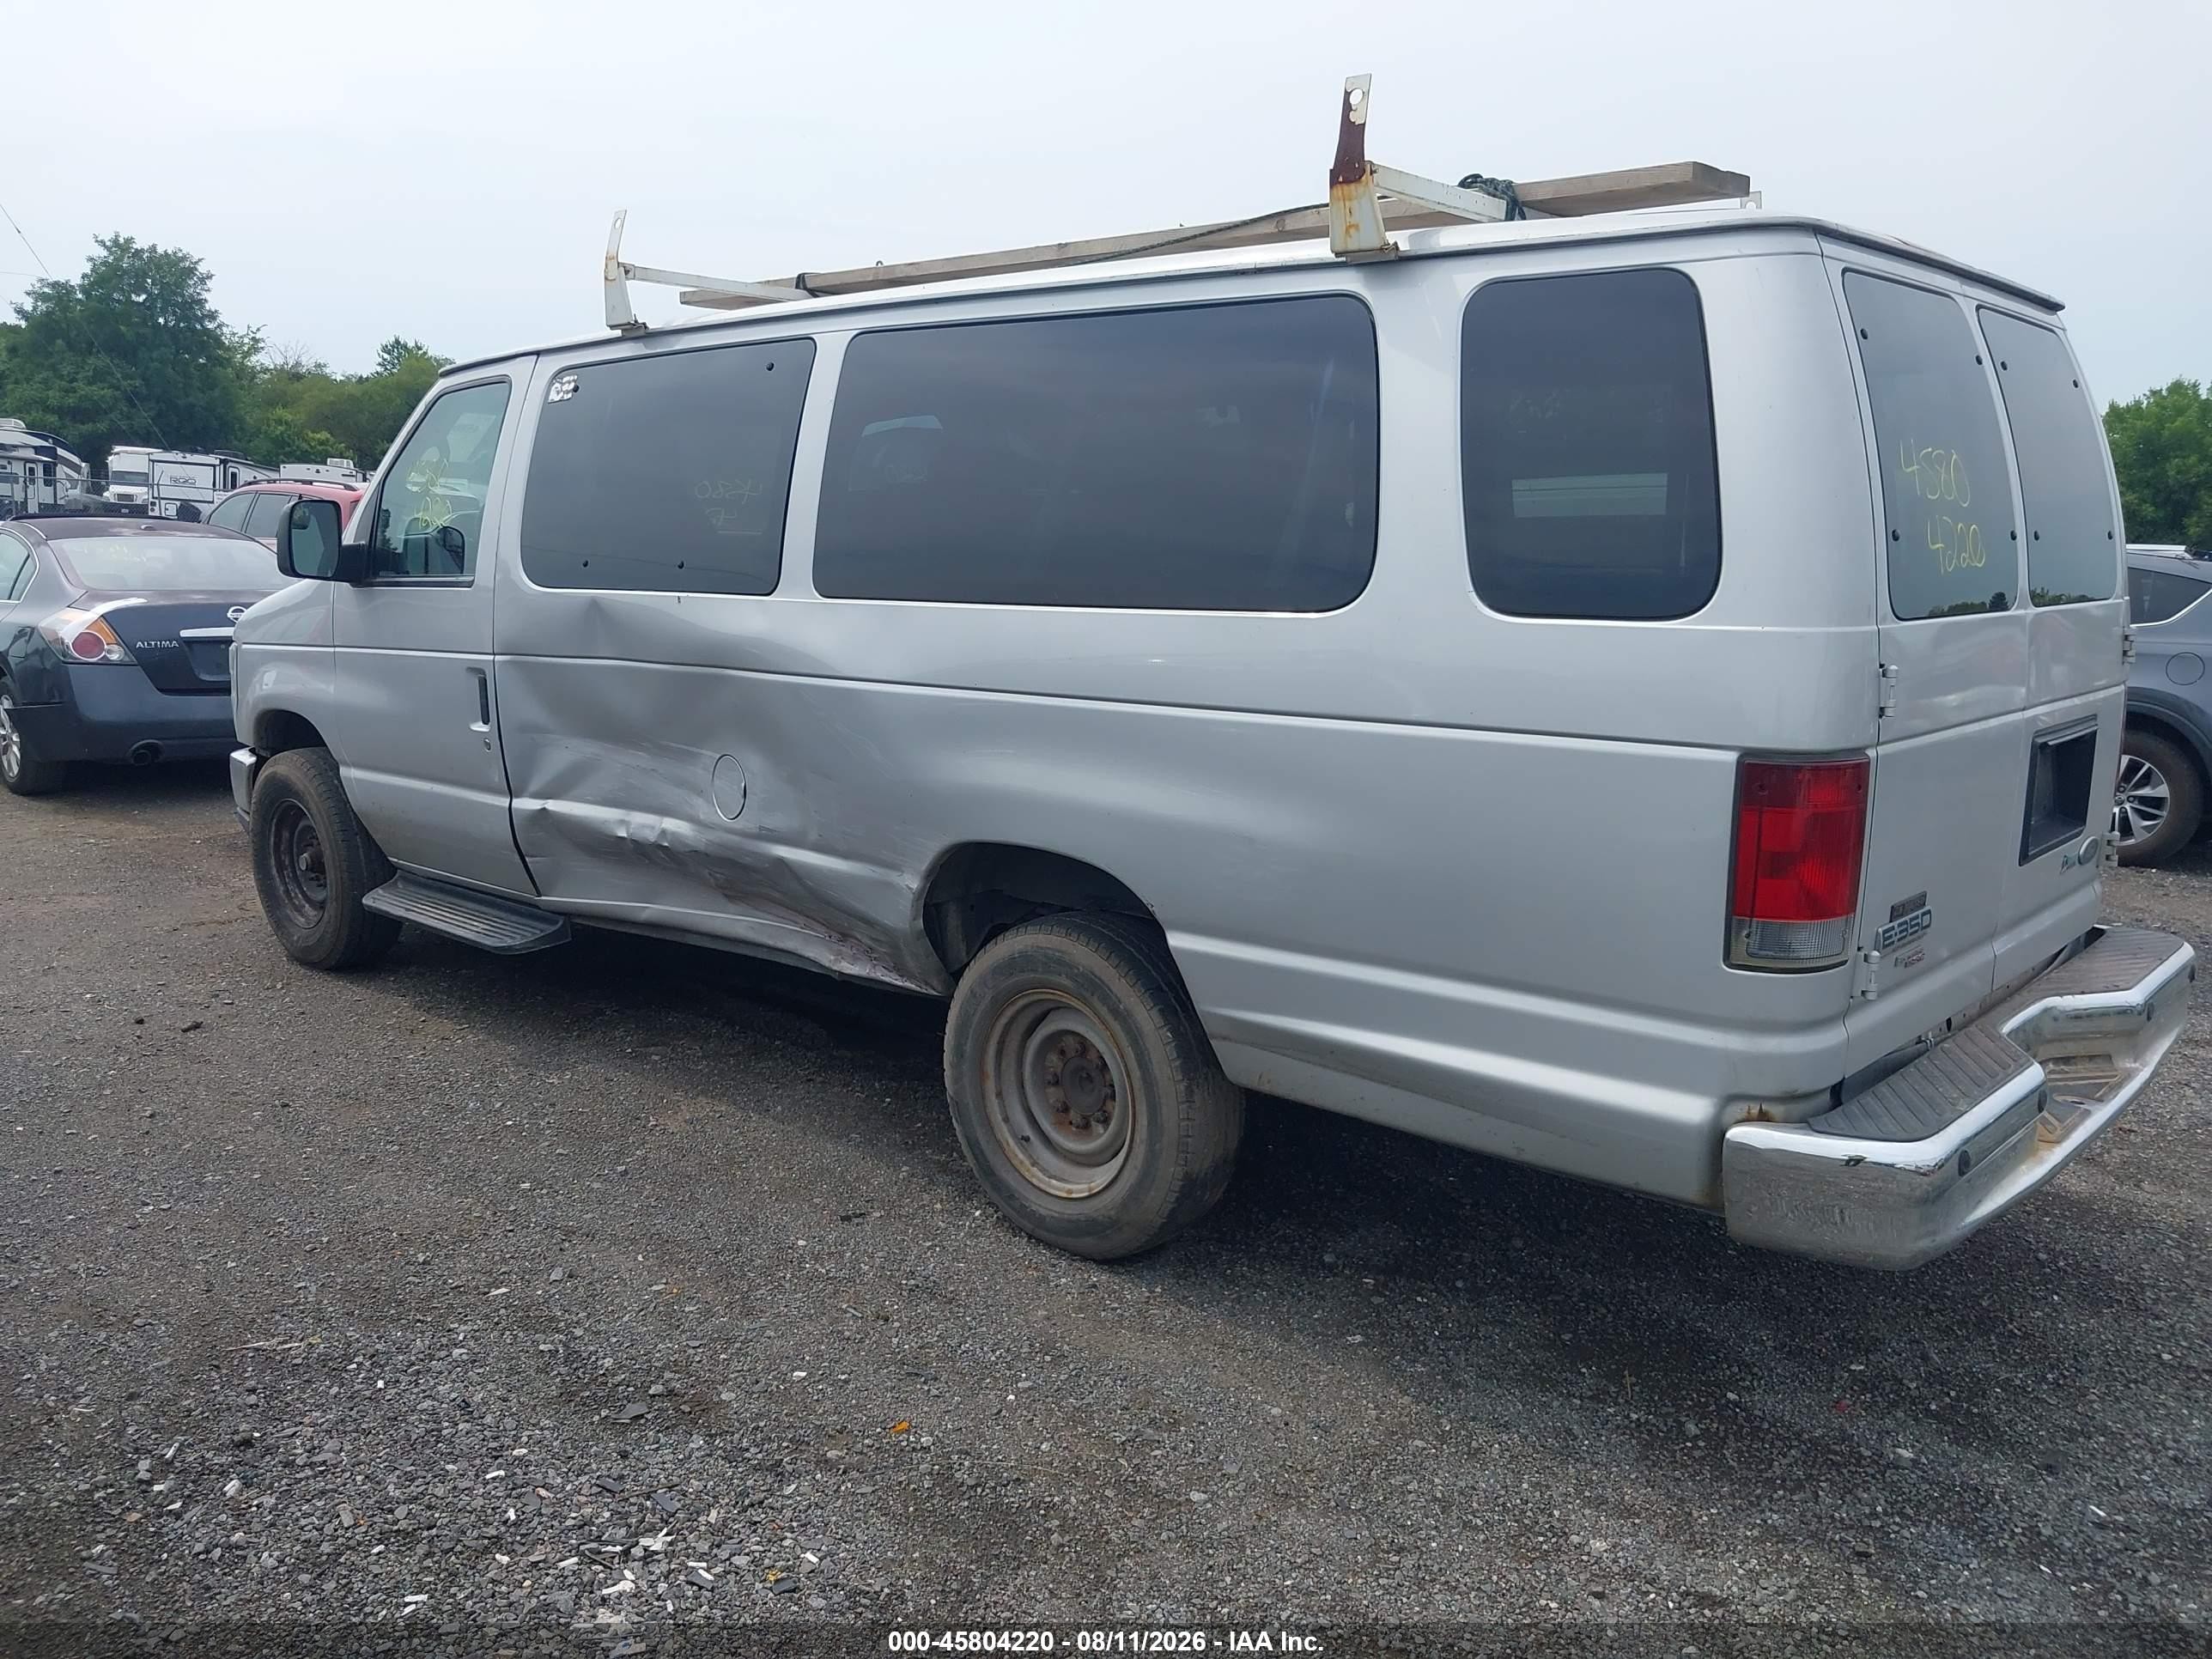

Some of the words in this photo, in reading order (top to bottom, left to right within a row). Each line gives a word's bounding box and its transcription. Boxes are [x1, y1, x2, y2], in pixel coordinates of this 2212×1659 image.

[1899, 439, 1970, 507] 4580
[1927, 514, 1986, 574] 4220
[136, 640, 179, 649] ALTIMA
